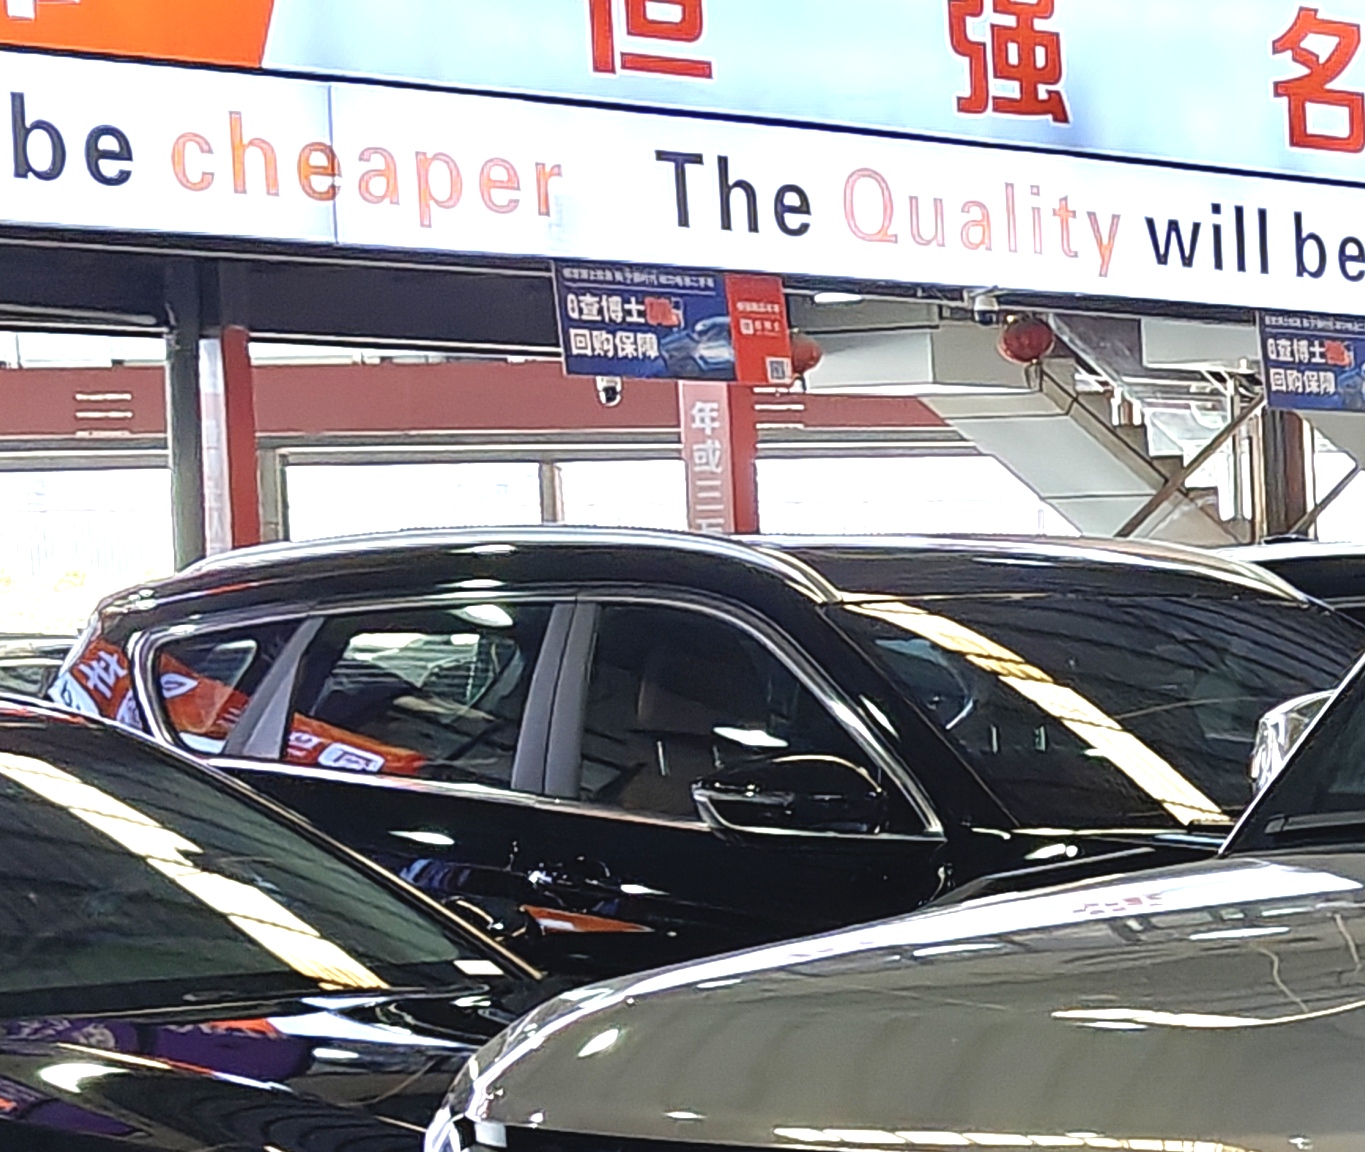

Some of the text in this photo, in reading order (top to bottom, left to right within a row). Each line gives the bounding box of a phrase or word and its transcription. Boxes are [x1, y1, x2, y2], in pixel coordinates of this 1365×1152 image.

[11, 91, 562, 228] be cheaper
[655, 149, 812, 236] The
[843, 168, 1120, 276] Quality
[1144, 203, 1269, 275] will
[569, 328, 659, 359] 回购保障
